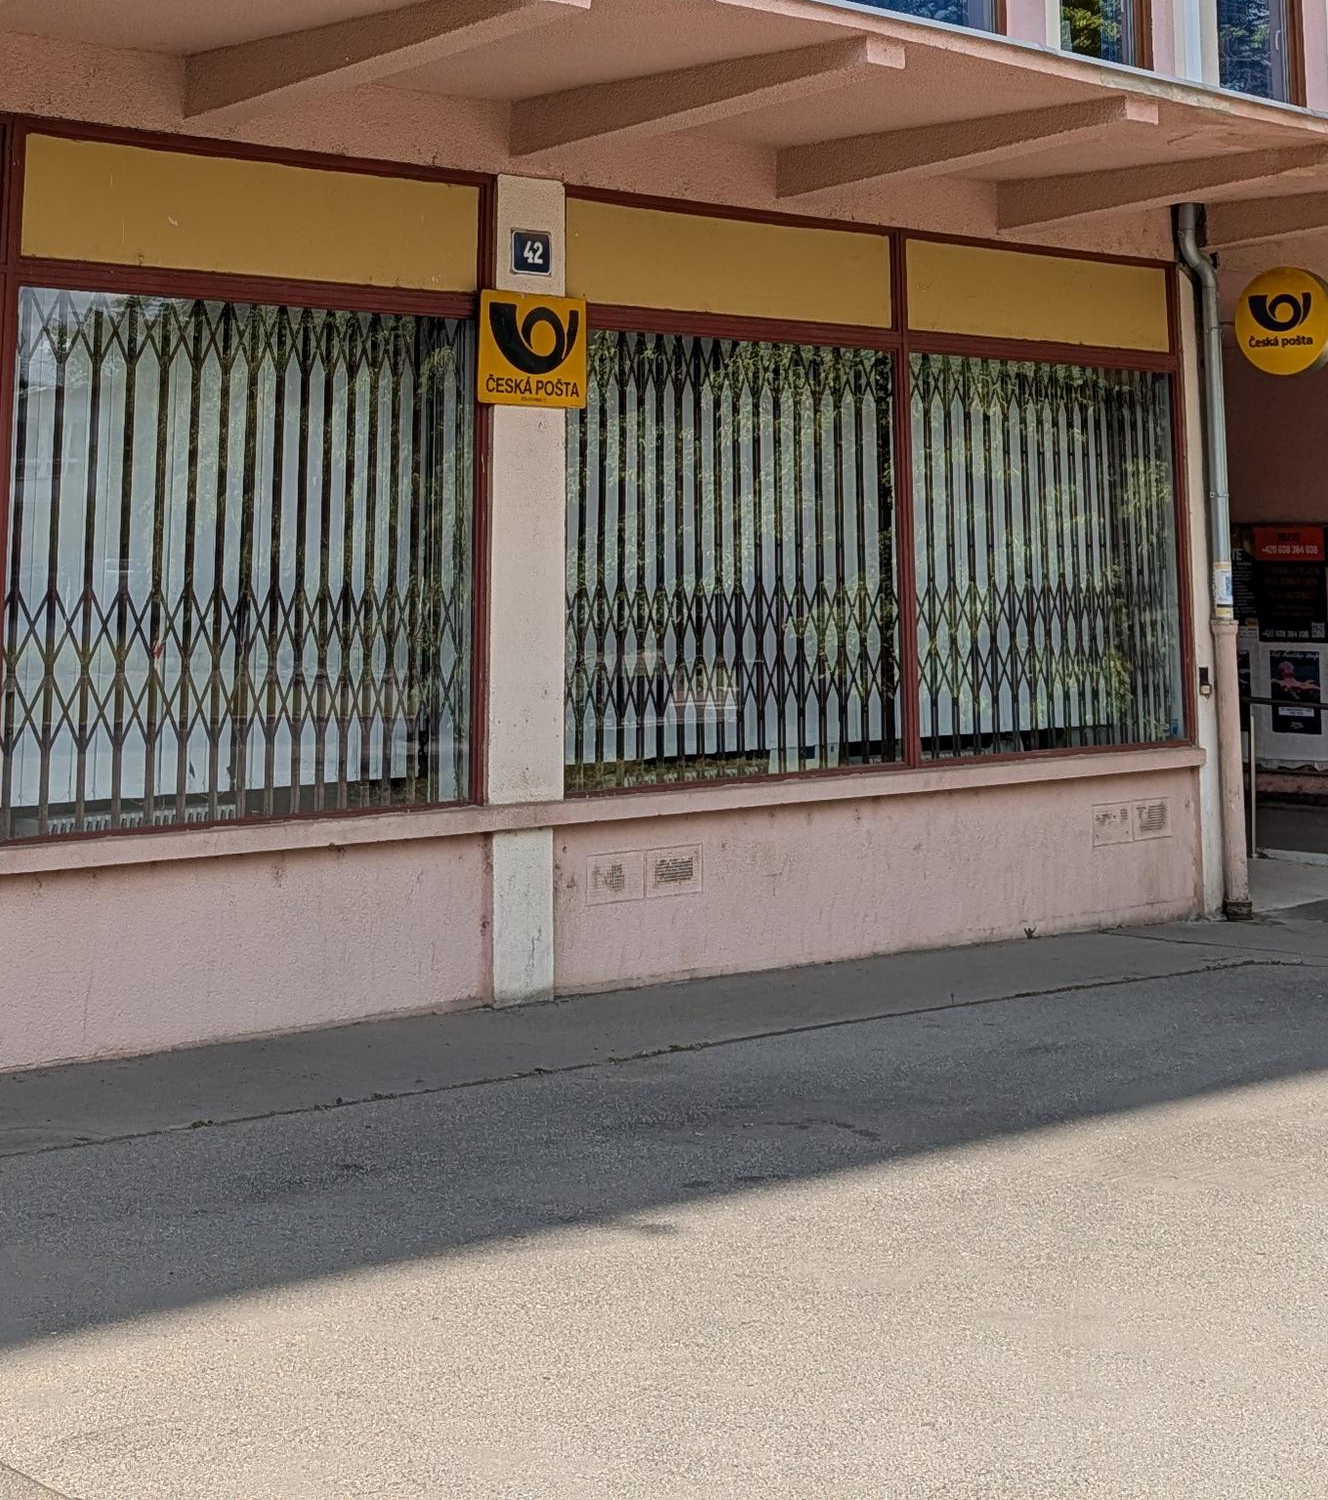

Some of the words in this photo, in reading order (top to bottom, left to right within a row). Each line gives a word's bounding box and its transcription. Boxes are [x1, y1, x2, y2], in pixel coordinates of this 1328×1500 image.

[523, 241, 543, 264] 42
[1249, 335, 1279, 348] Česká
[1281, 335, 1313, 348] pošta
[486, 374, 533, 395] ČESKÁ
[535, 379, 580, 398] POŠTA
